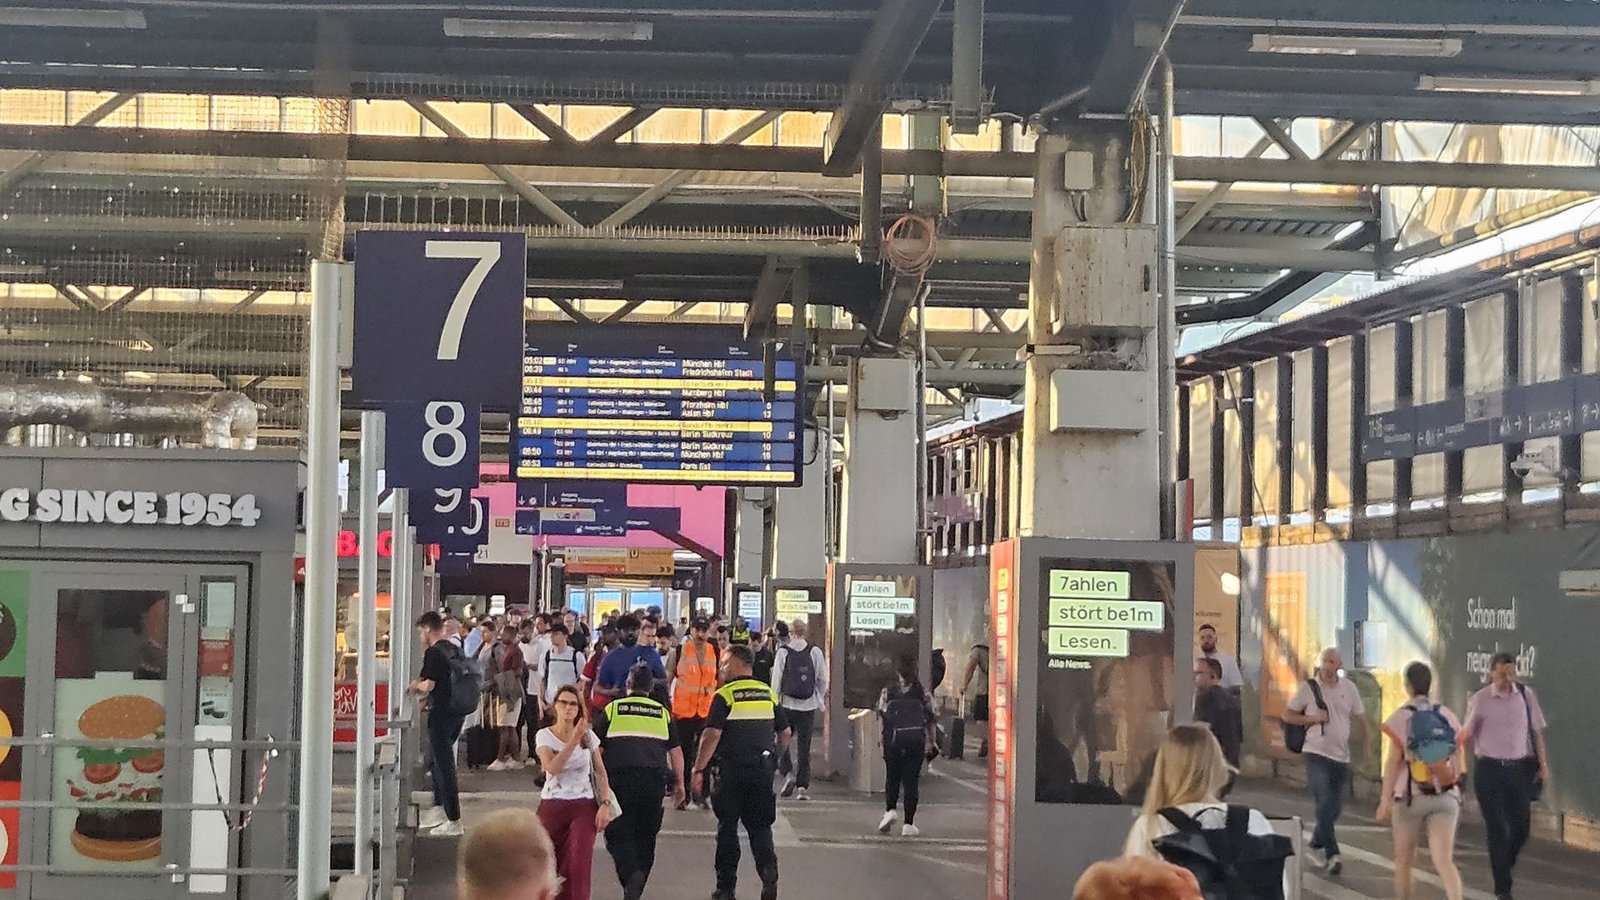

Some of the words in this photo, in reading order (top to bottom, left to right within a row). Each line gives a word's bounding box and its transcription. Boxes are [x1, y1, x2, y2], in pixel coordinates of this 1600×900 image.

[425, 240, 501, 360] 7
[682, 360, 713, 368] München
[714, 360, 726, 368] Hbf
[422, 401, 467, 467] 8
[36, 488, 159, 524] SINCE
[165, 491, 261, 527] 1954
[477, 549, 489, 559] 21
[1060, 576, 1118, 592] 7ahlen
[1059, 605, 1103, 621] stört
[1107, 607, 1153, 622] be1m
[1467, 597, 1495, 628] Schon
[1497, 596, 1517, 630] mal
[1059, 633, 1117, 650] Lesen.
[1048, 659, 1065, 668] Alle
